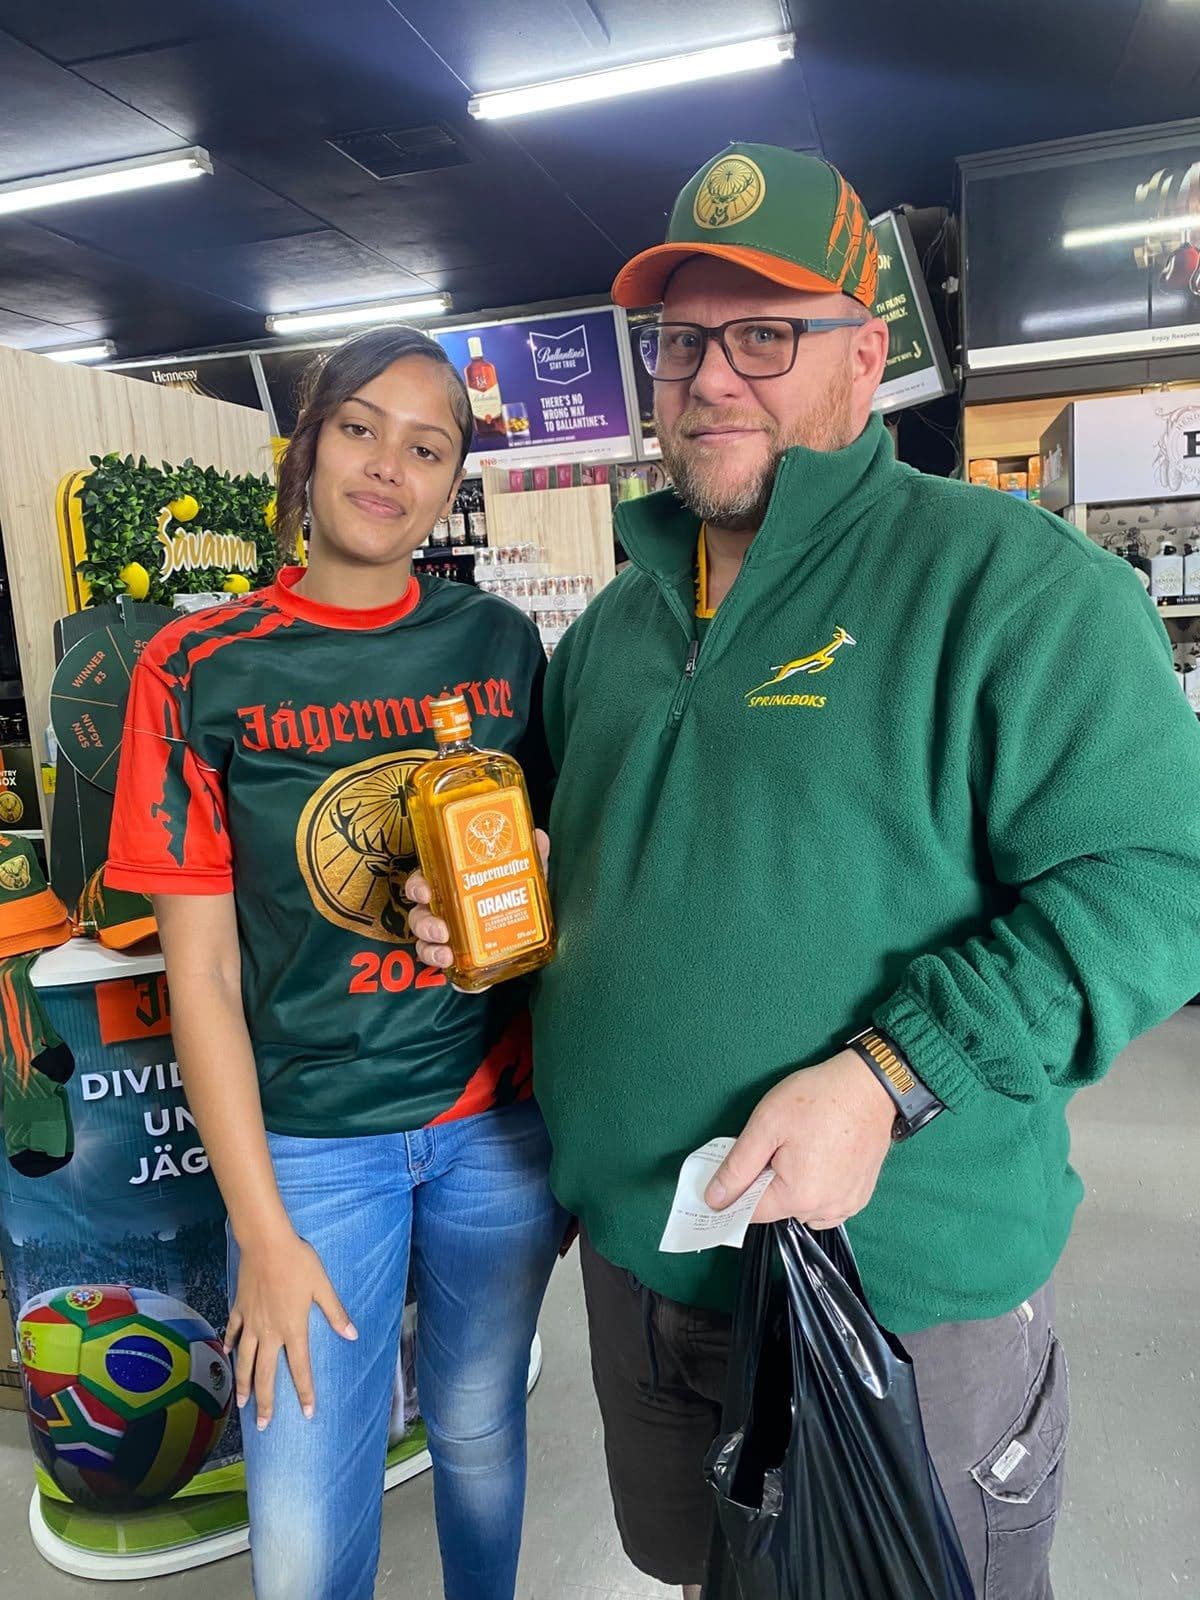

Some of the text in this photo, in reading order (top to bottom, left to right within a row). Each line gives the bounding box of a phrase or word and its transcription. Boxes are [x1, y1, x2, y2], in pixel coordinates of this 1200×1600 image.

[537, 346, 585, 364] Ballantine's
[152, 369, 198, 383] Hennessy
[540, 393, 583, 409] THERE'S NO
[542, 405, 585, 420] WRONG WAY
[544, 414, 609, 433] TO BALLANTINE'S.
[157, 506, 257, 583] Savanna
[71, 650, 106, 688] WINNER
[94, 670, 107, 685] #3
[748, 694, 827, 708] SPRINGBOKS
[71, 721, 90, 749] SPIN
[81, 713, 104, 748] AGAIN
[477, 886, 529, 918] ORANGE
